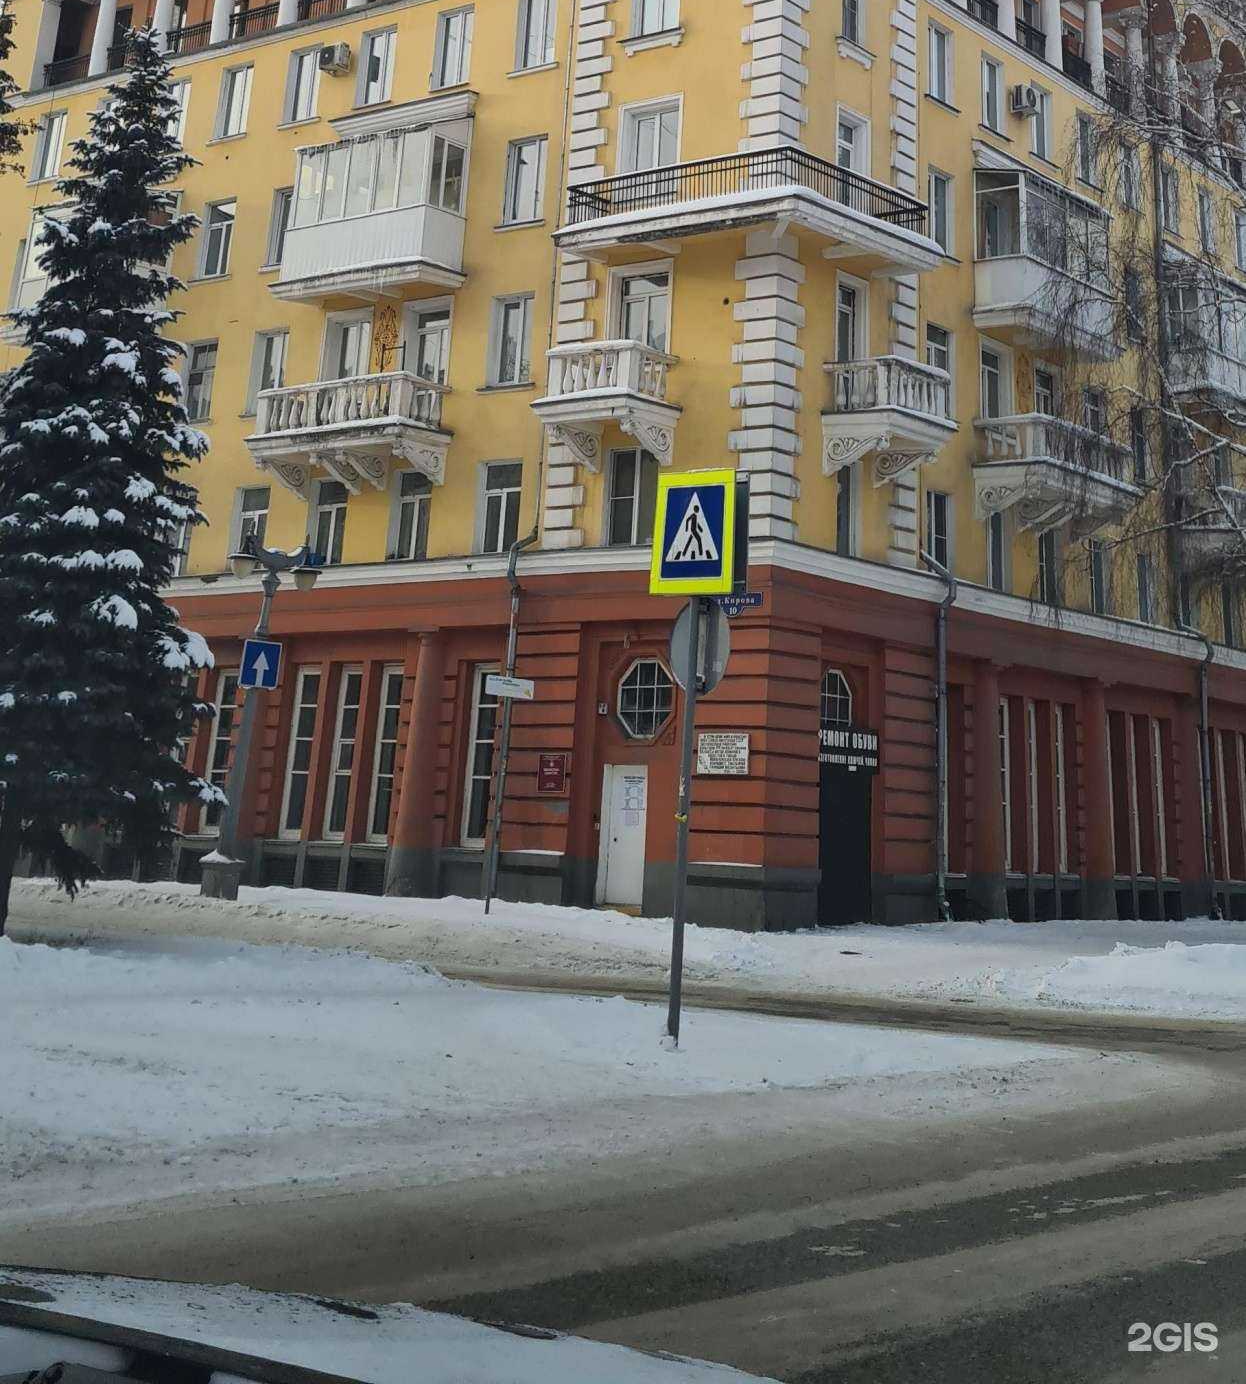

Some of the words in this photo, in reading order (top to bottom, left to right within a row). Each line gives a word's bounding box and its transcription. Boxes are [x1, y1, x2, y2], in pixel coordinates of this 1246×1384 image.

[730, 606, 738, 615] 10
[818, 729, 849, 748] РЕМОНТ
[852, 732, 878, 751] ОБУВИ
